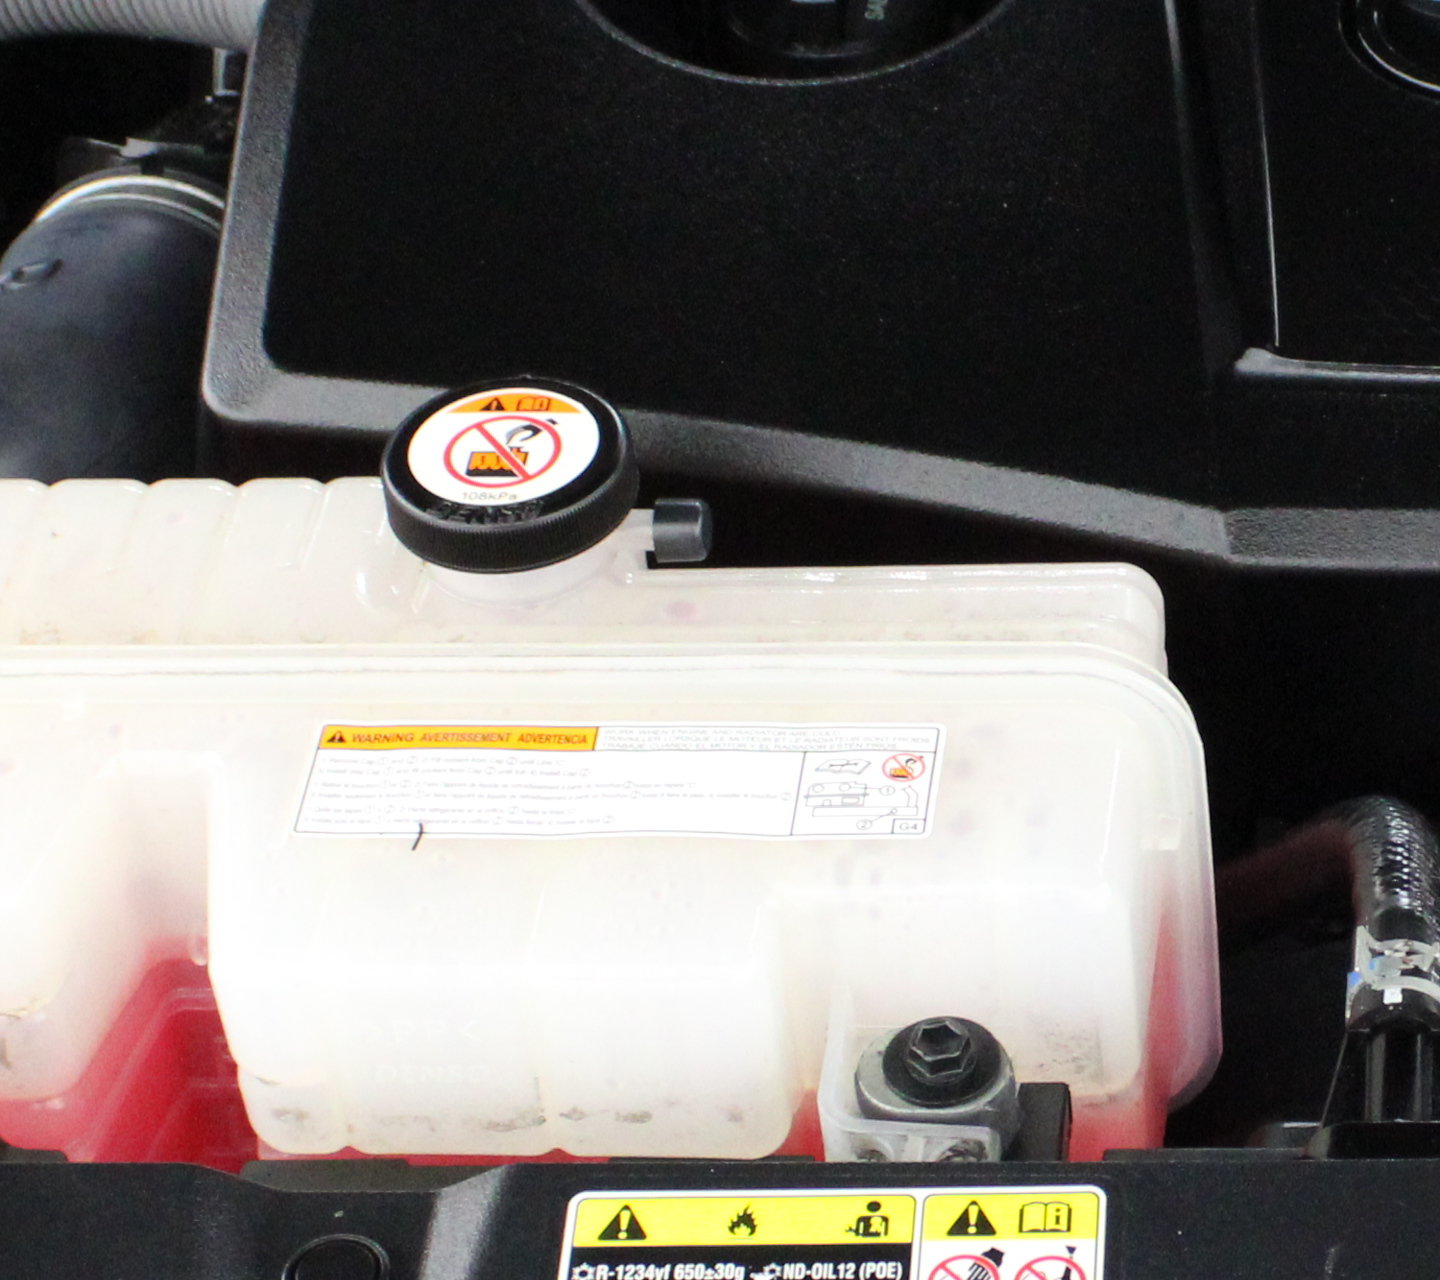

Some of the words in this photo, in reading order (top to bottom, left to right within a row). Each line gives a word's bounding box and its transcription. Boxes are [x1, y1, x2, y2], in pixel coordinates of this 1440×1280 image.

[461, 489, 519, 502] 108kPa
[351, 732, 415, 743] WARNING
[419, 732, 512, 743] AVERTISSEMENT
[517, 733, 589, 745] ADVERTENCIA
[898, 821, 920, 832] G4
[782, 1261, 856, 1280] ND-OIL12
